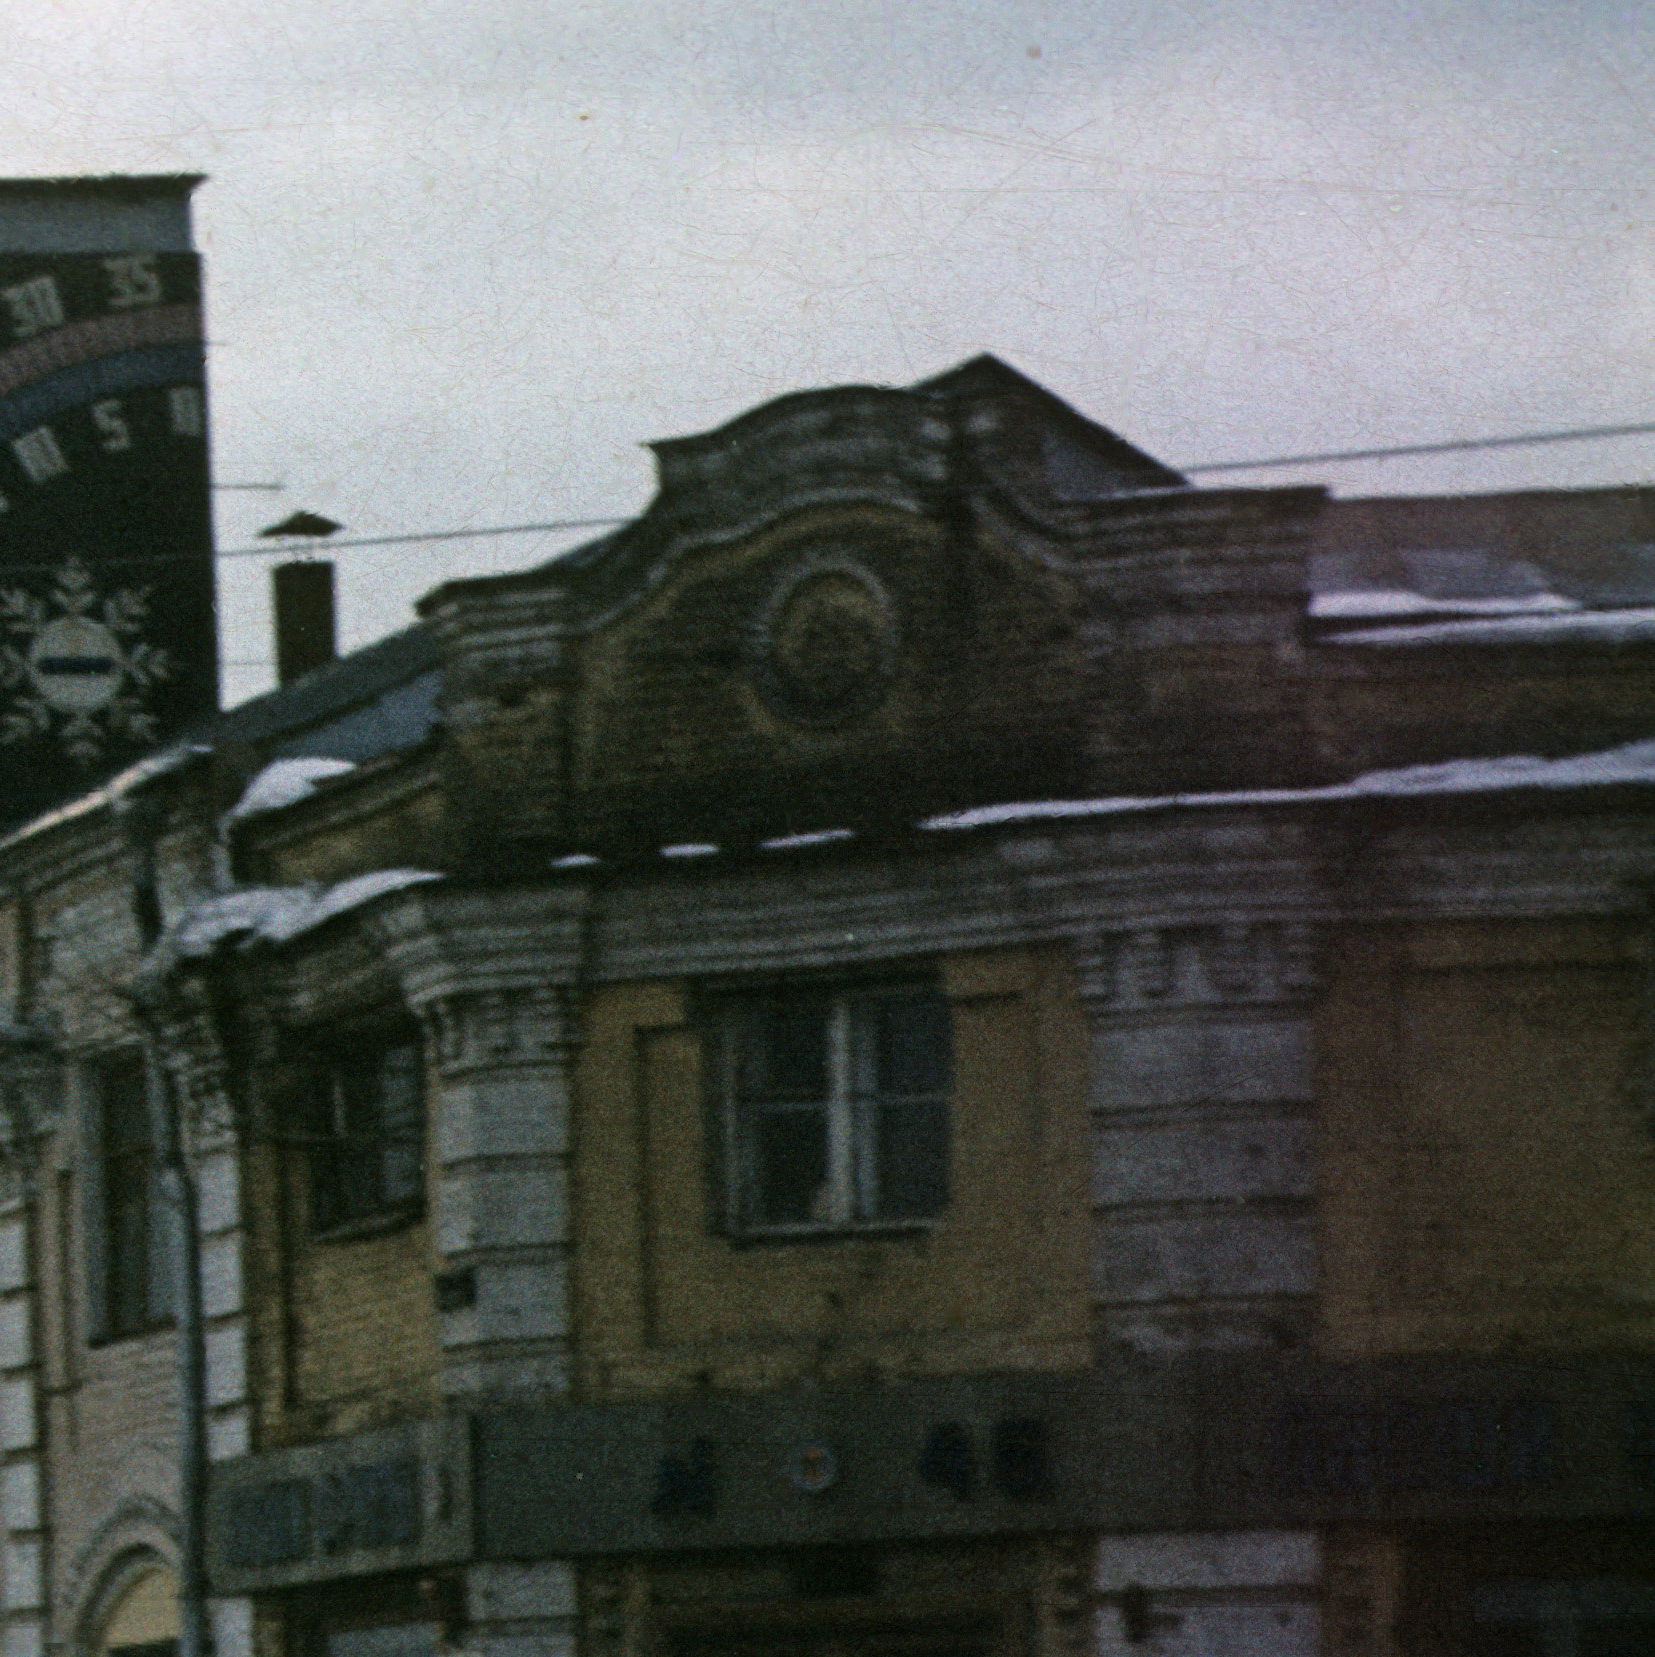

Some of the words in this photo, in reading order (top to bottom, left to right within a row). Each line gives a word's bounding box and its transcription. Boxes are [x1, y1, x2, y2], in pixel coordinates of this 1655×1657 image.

[0, 275, 65, 338] 30
[102, 252, 164, 308] 35
[92, 398, 132, 452] 5
